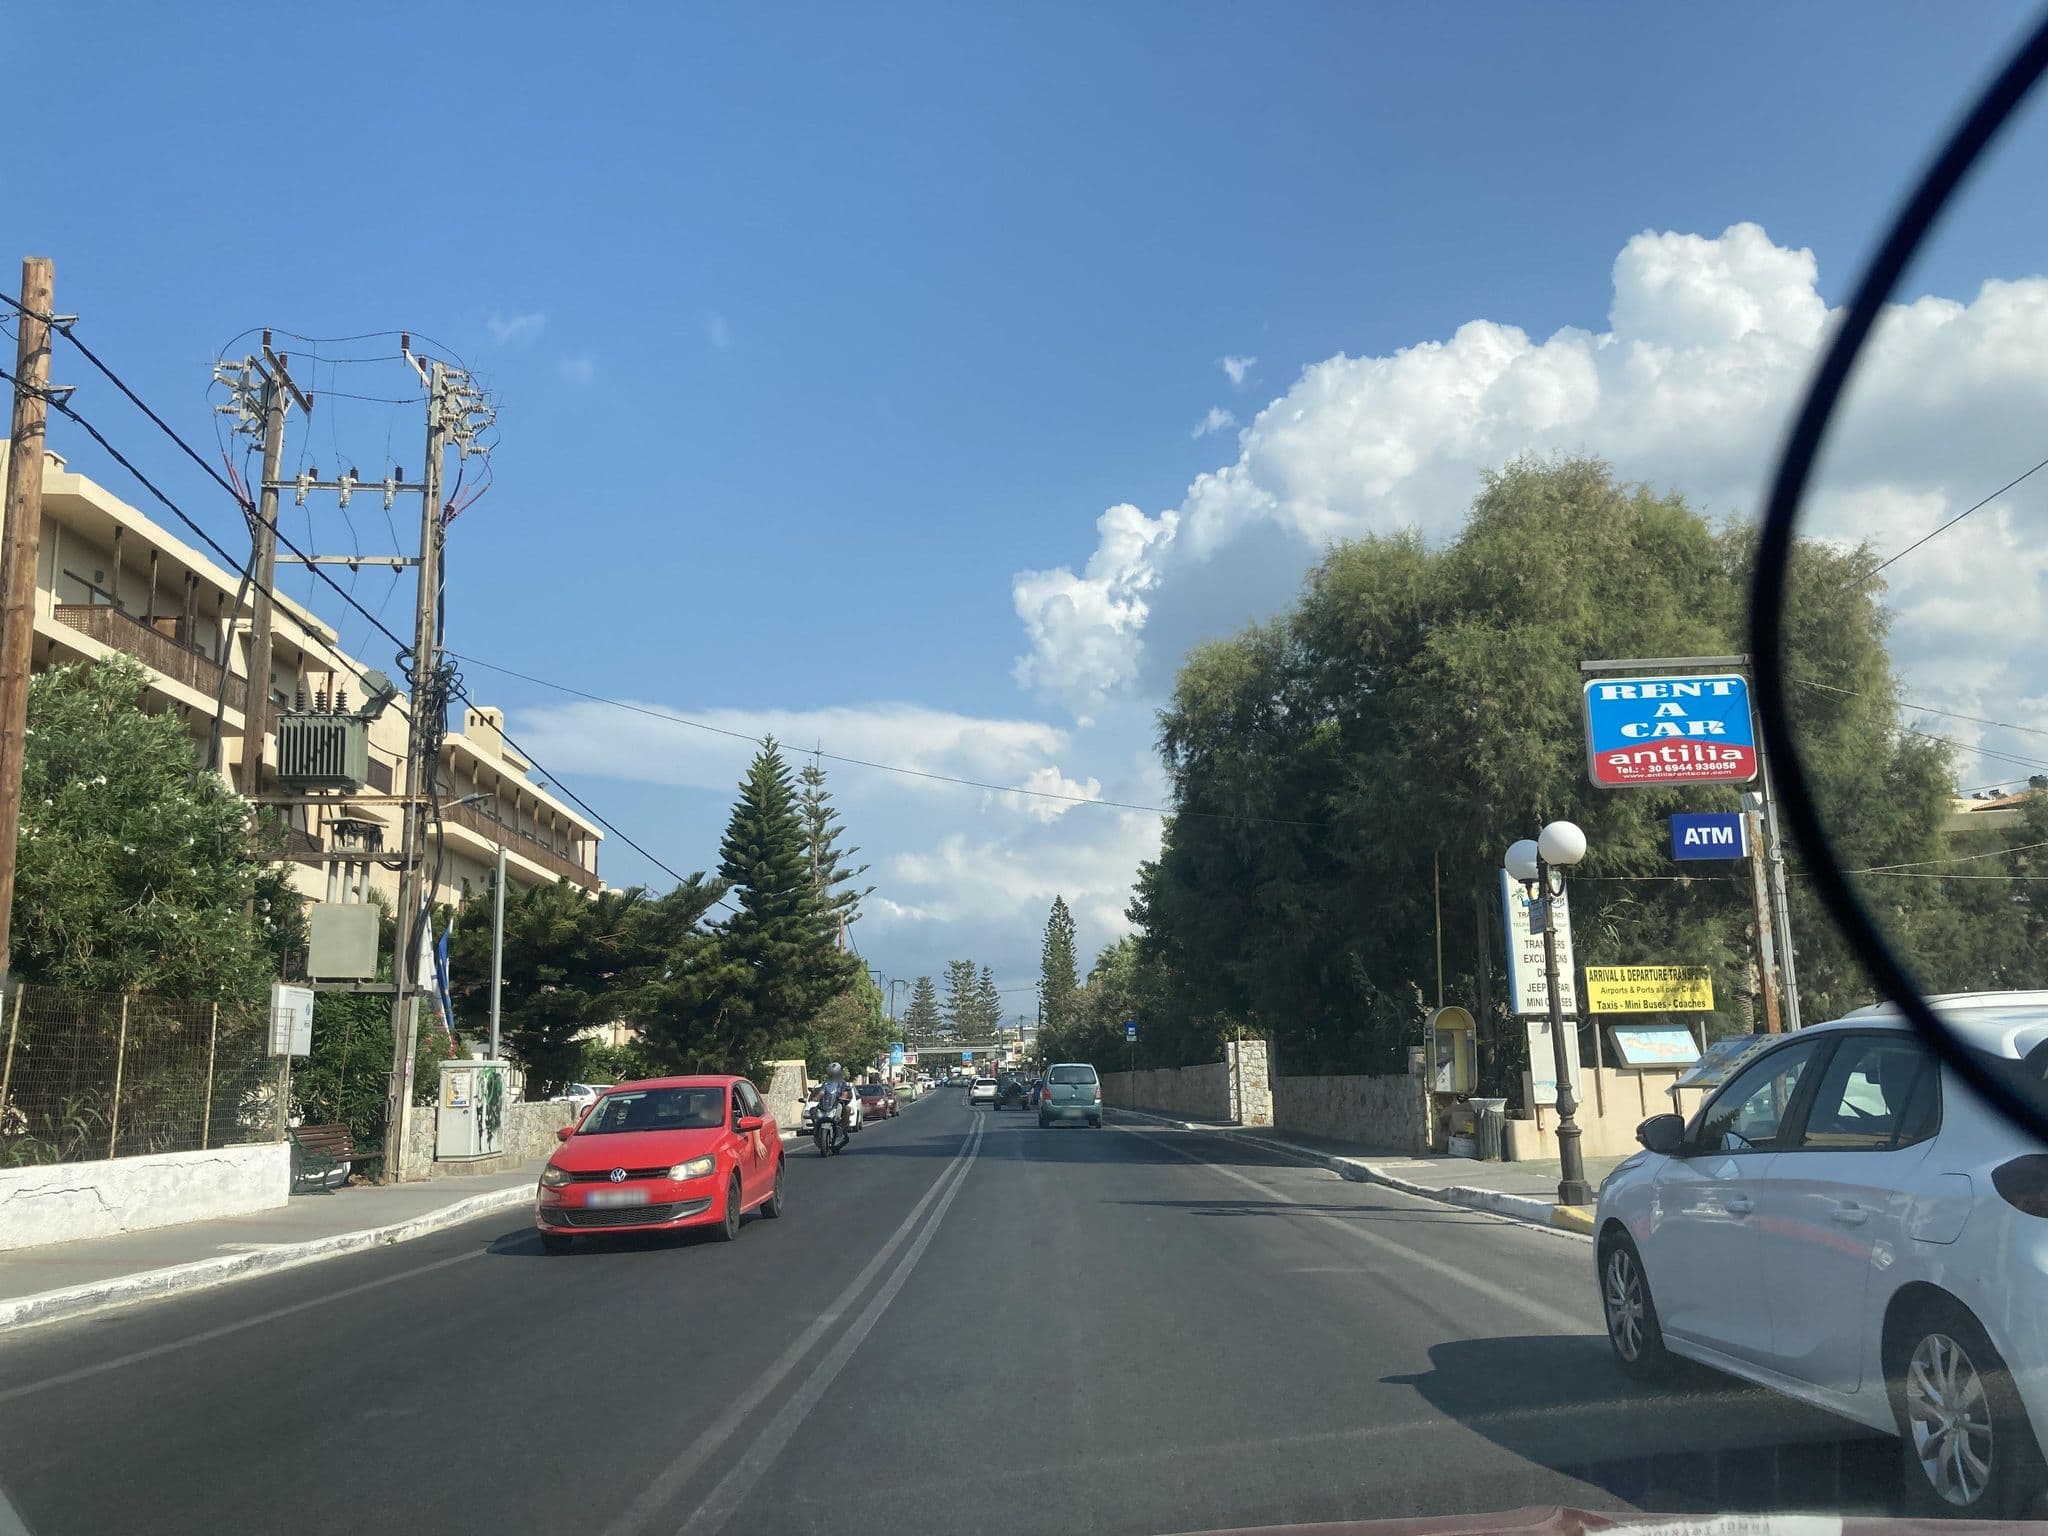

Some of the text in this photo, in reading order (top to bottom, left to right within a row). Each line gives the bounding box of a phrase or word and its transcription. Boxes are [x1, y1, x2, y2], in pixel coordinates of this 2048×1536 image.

[1599, 681, 1737, 700] RENT
[1653, 702, 1688, 718] A
[1620, 720, 1726, 738] CAR
[1608, 745, 1744, 765] antilia
[1616, 765, 1639, 774] Tel.:
[1648, 764, 1663, 773] 30
[1665, 763, 1693, 772] 6944
[1696, 761, 1737, 770] 936058
[1684, 827, 1734, 845] ATM
[1524, 940, 1566, 950] TRANERS
[1589, 969, 1618, 982] ARRIVAL
[1620, 969, 1626, 982] &
[1627, 969, 1667, 981] DEPARTURE
[1527, 983, 1546, 993] JEEP
[1601, 986, 1628, 995] Airports
[1527, 998, 1544, 1007] MINI
[1596, 1001, 1618, 1010] Taxis
[1624, 1000, 1641, 1009] Mini
[1643, 1000, 1667, 1009] Buses
[1673, 999, 1706, 1009] Coaches
